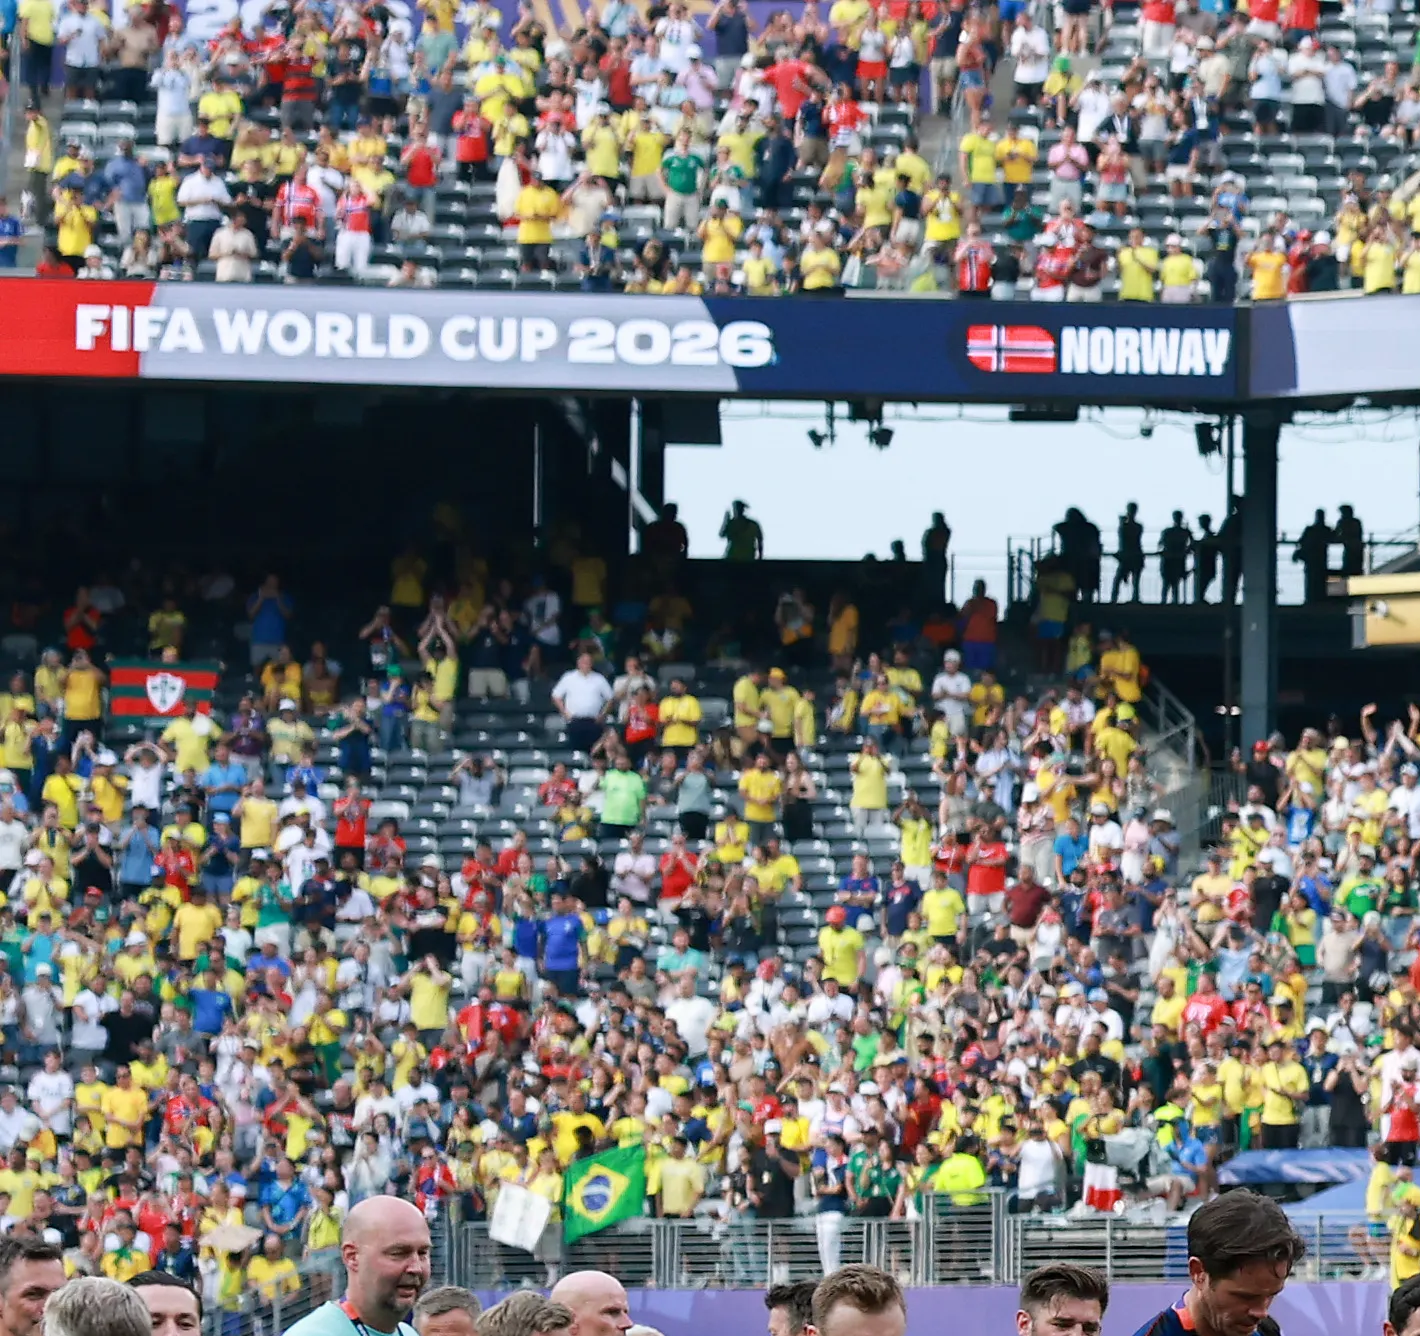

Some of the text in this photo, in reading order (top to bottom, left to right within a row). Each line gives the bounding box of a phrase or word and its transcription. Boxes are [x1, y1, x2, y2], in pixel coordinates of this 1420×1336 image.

[75, 304, 774, 368] FIFA WORLD CUP 2026
[1060, 325, 1231, 376] NORWAY
